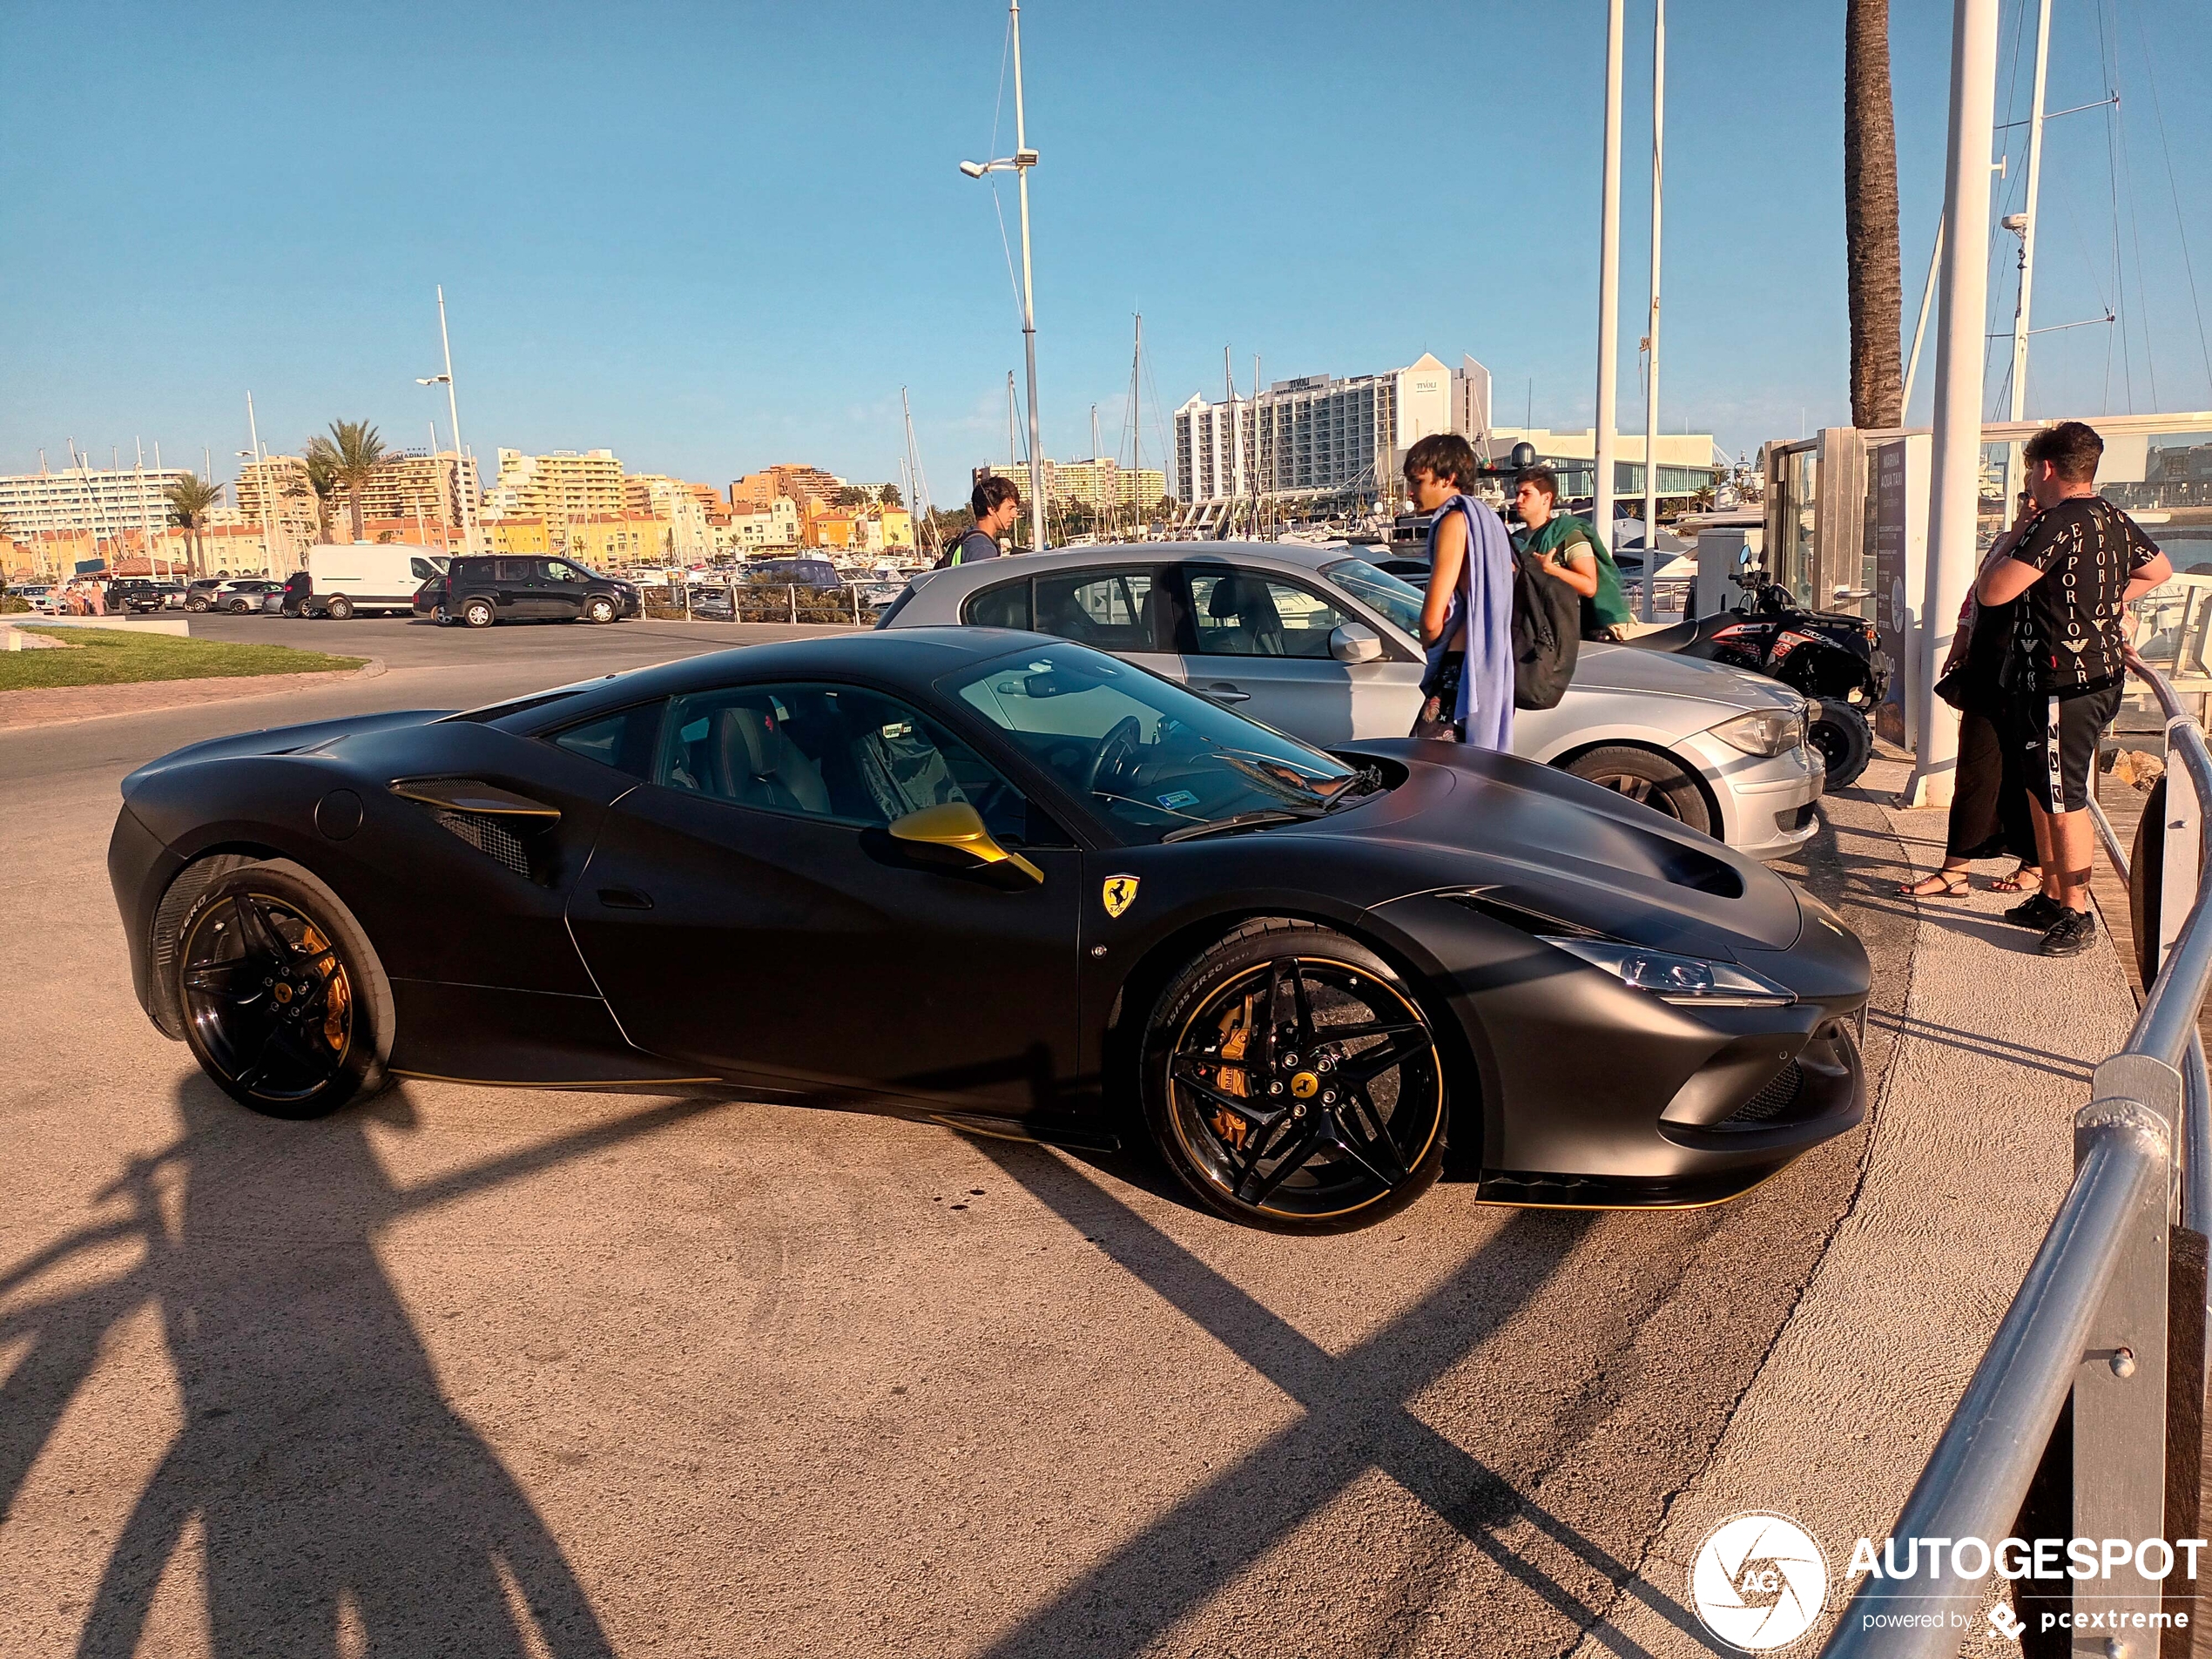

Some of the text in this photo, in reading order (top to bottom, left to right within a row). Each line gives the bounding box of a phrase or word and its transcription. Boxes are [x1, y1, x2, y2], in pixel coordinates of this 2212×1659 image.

[1289, 375, 1310, 388] TIVOLI
[1416, 380, 1437, 388] TIVOLI
[2054, 523, 2084, 637] EMPORIO
[1191, 962, 1224, 993] ZR20
